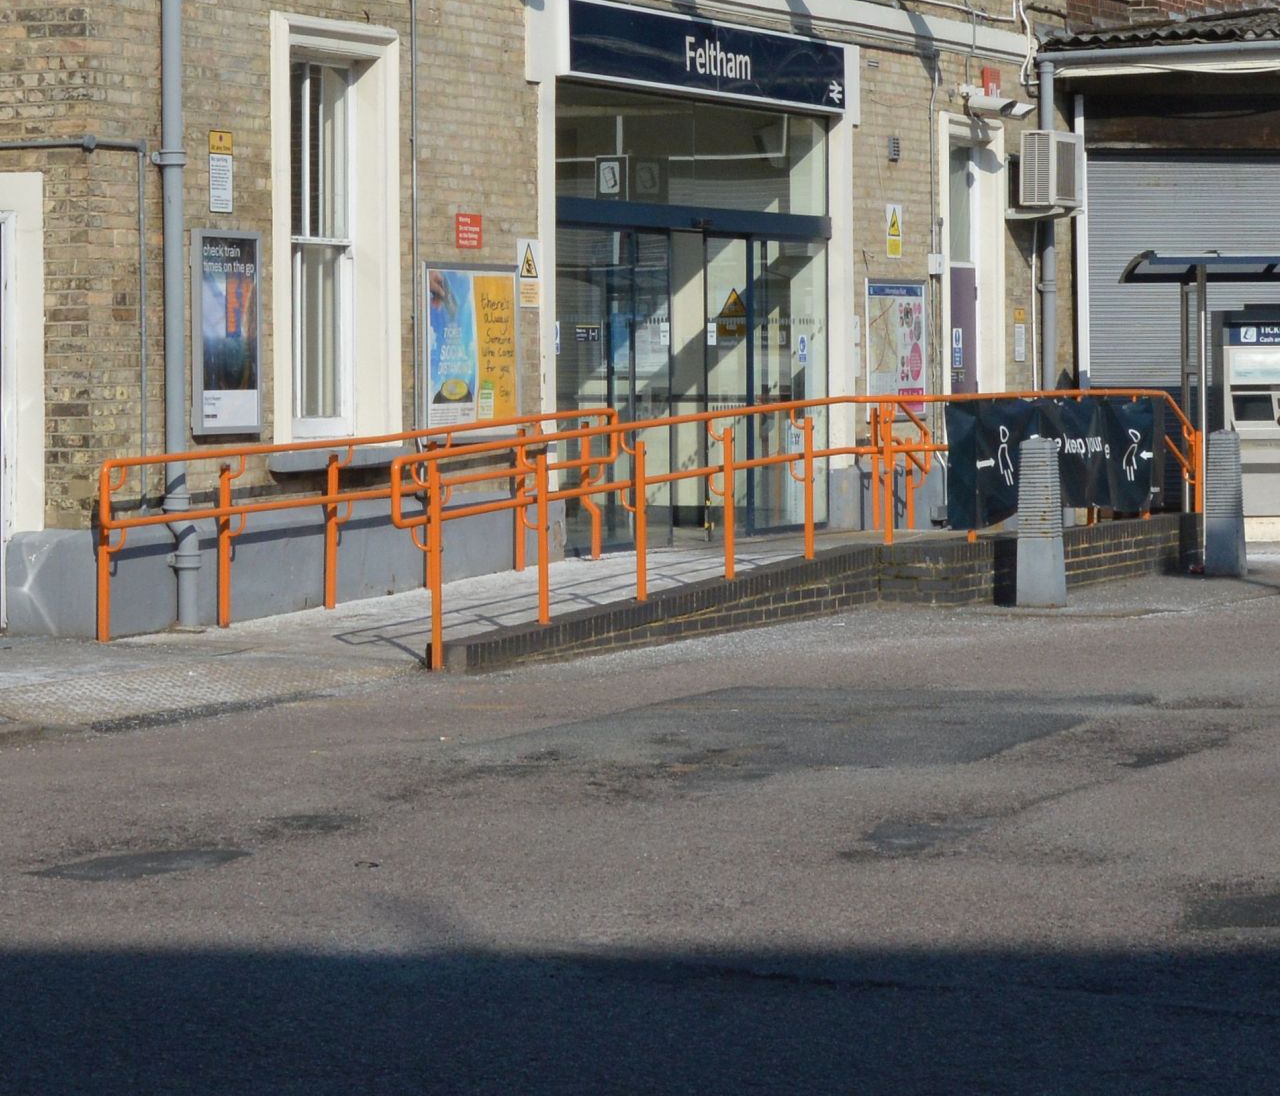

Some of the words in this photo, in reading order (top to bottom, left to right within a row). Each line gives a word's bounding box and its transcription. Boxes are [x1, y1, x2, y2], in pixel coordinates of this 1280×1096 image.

[685, 35, 751, 80] Feltham
[203, 244, 224, 257] check
[224, 245, 240, 257] train
[203, 261, 223, 272] times
[223, 263, 233, 272] on
[233, 260, 245, 273] the
[245, 264, 255, 276] go
[1063, 433, 1086, 459] kep
[1086, 436, 1103, 458] your
